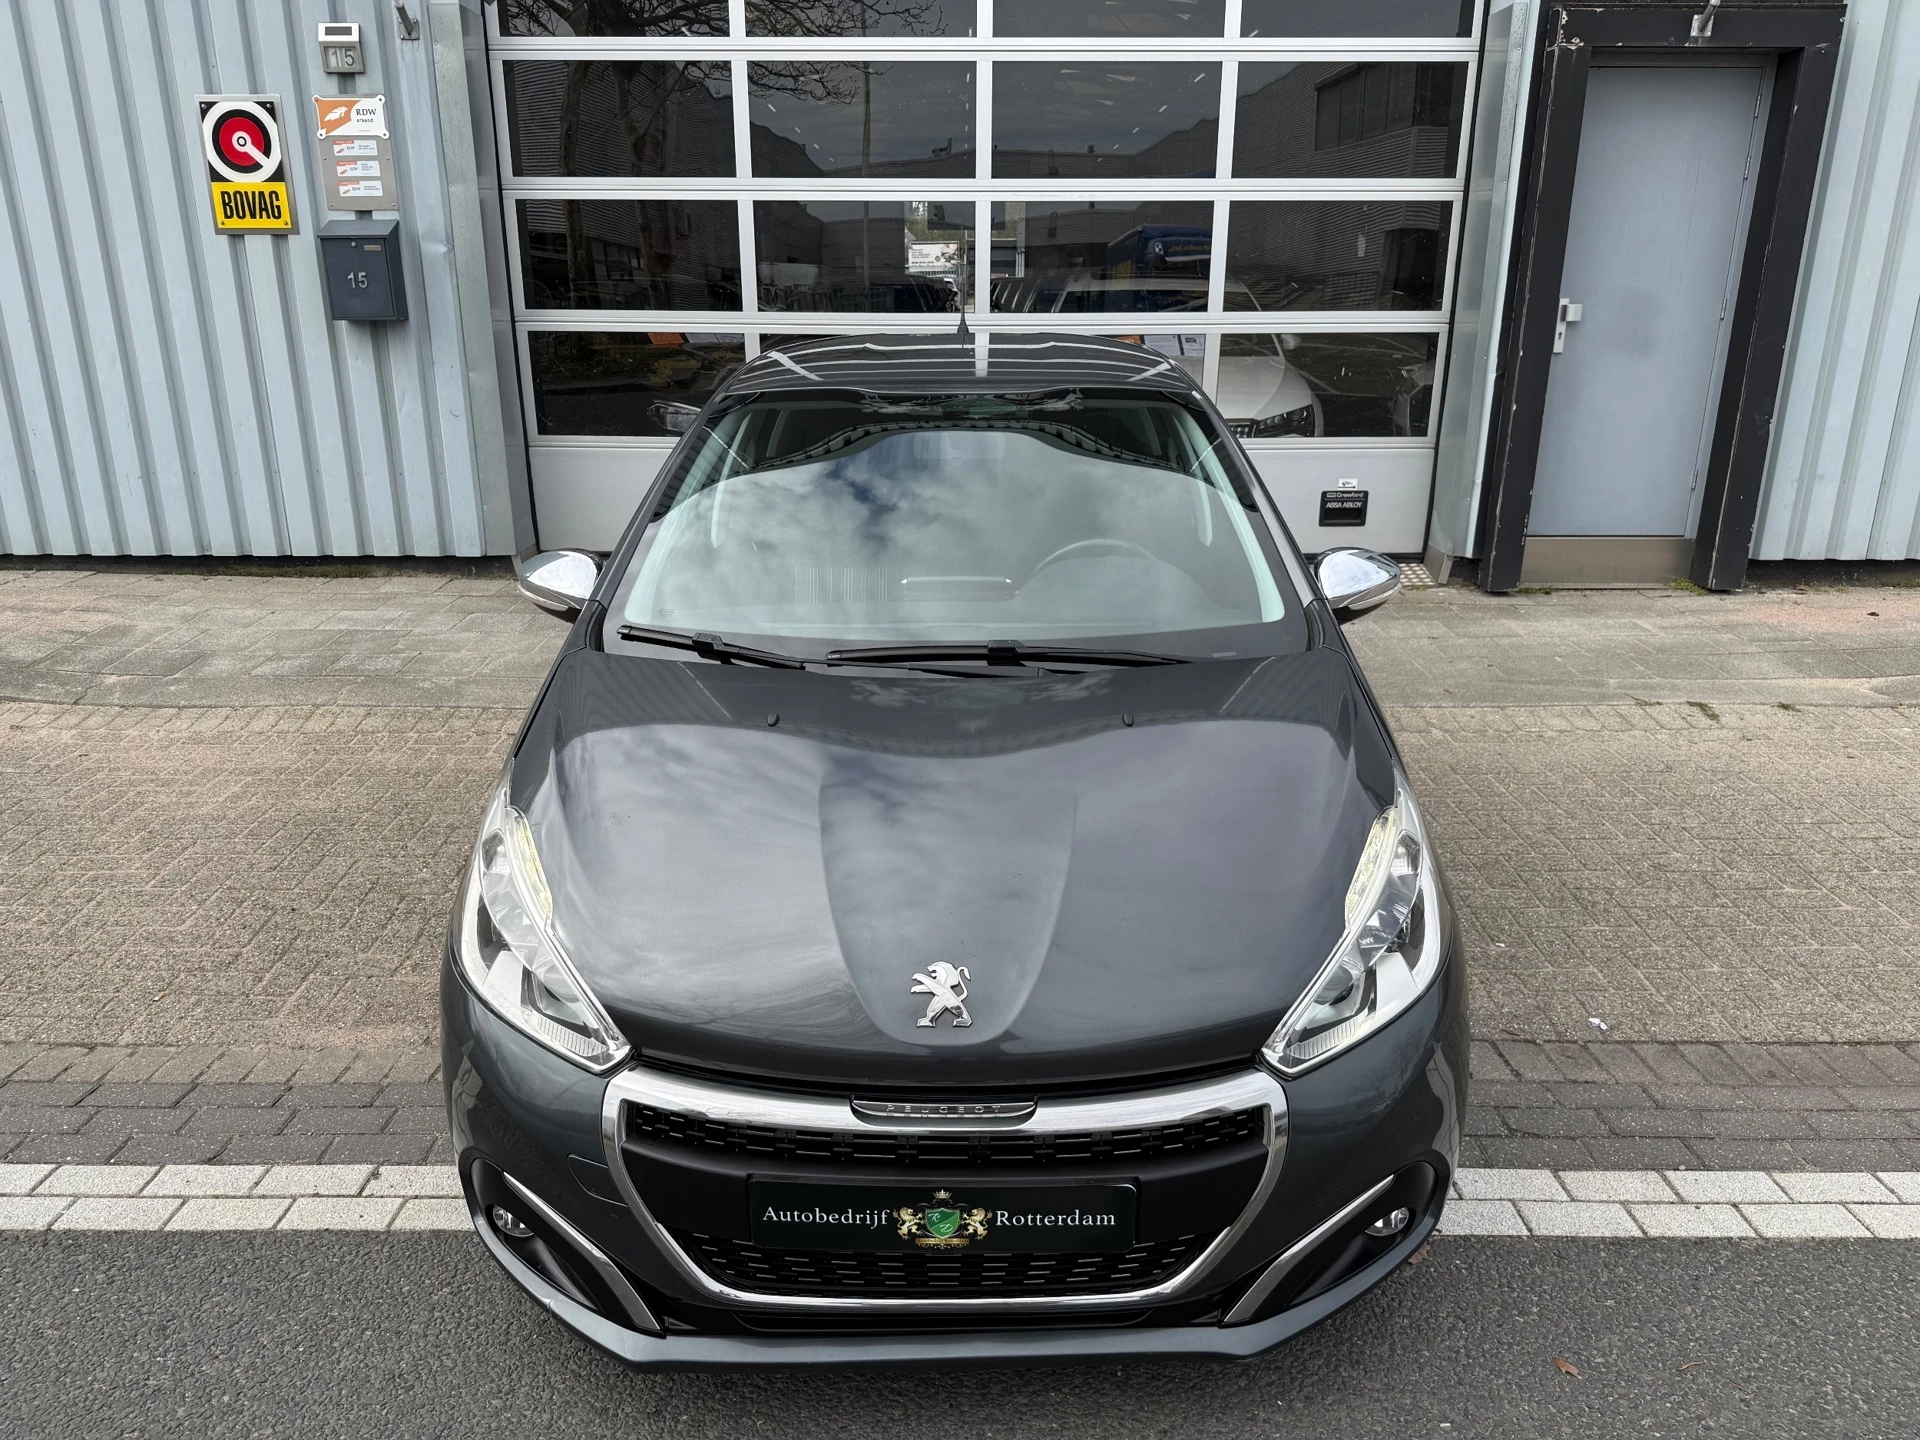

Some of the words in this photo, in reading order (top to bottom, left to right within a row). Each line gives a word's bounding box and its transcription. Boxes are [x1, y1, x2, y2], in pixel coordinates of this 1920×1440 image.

[331, 48, 355, 67] 15
[355, 108, 377, 116] RDW
[220, 190, 282, 220] BOVAG
[347, 272, 368, 289] 15
[762, 1206, 891, 1230] Autobedrijf
[995, 1209, 1117, 1226] Rotterdam
